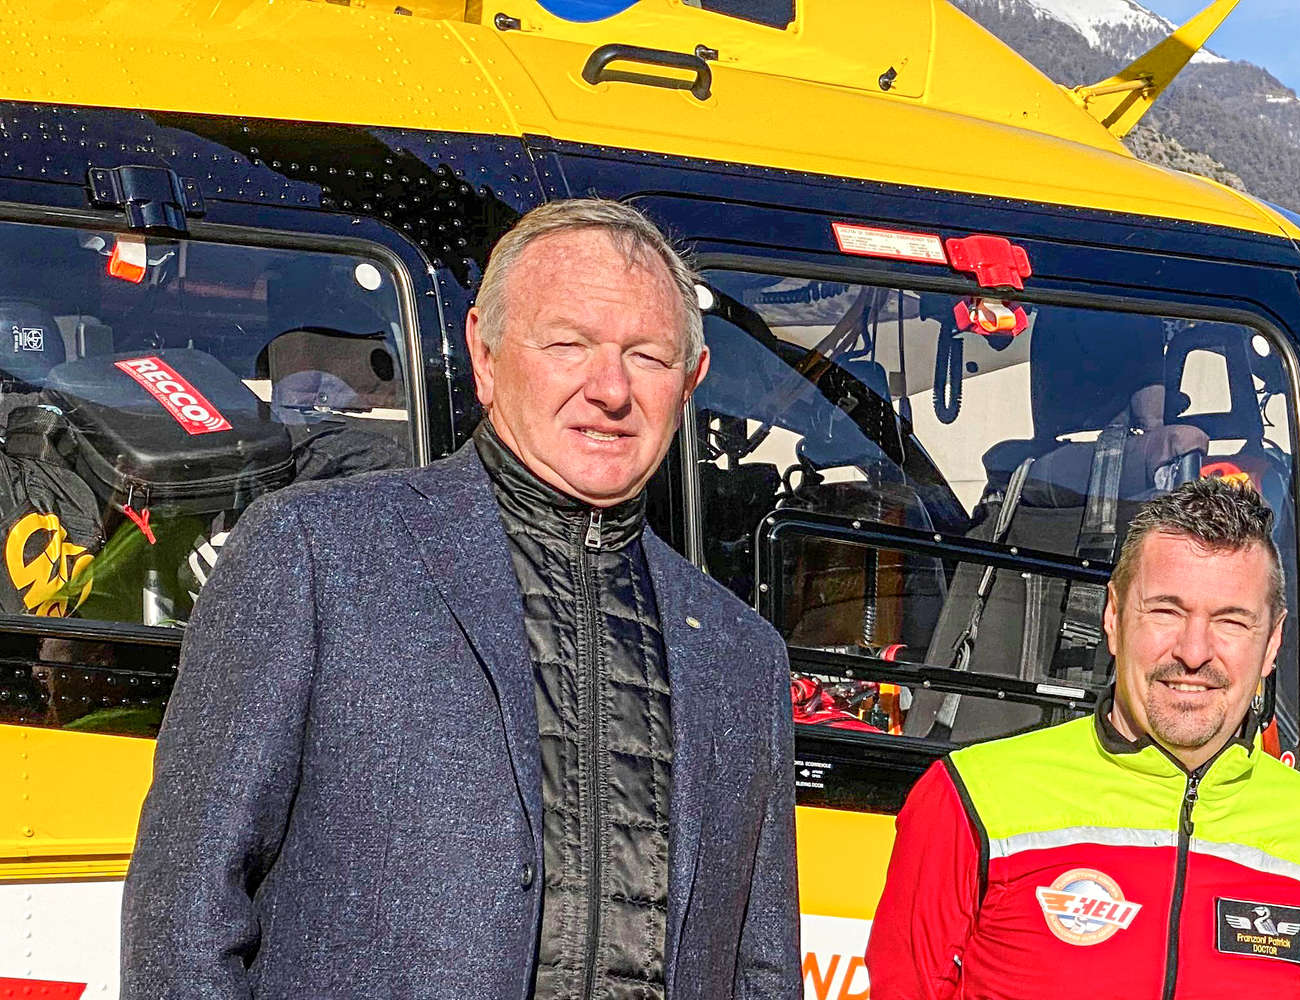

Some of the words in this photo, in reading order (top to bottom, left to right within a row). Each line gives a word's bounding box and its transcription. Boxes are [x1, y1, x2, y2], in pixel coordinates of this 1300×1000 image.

[127, 360, 210, 422] RECCO
[1073, 897, 1133, 923] HELI
[1237, 933, 1267, 944] Franzoni
[1268, 936, 1291, 949] Patrick
[1253, 944, 1278, 955] DOCTOR
